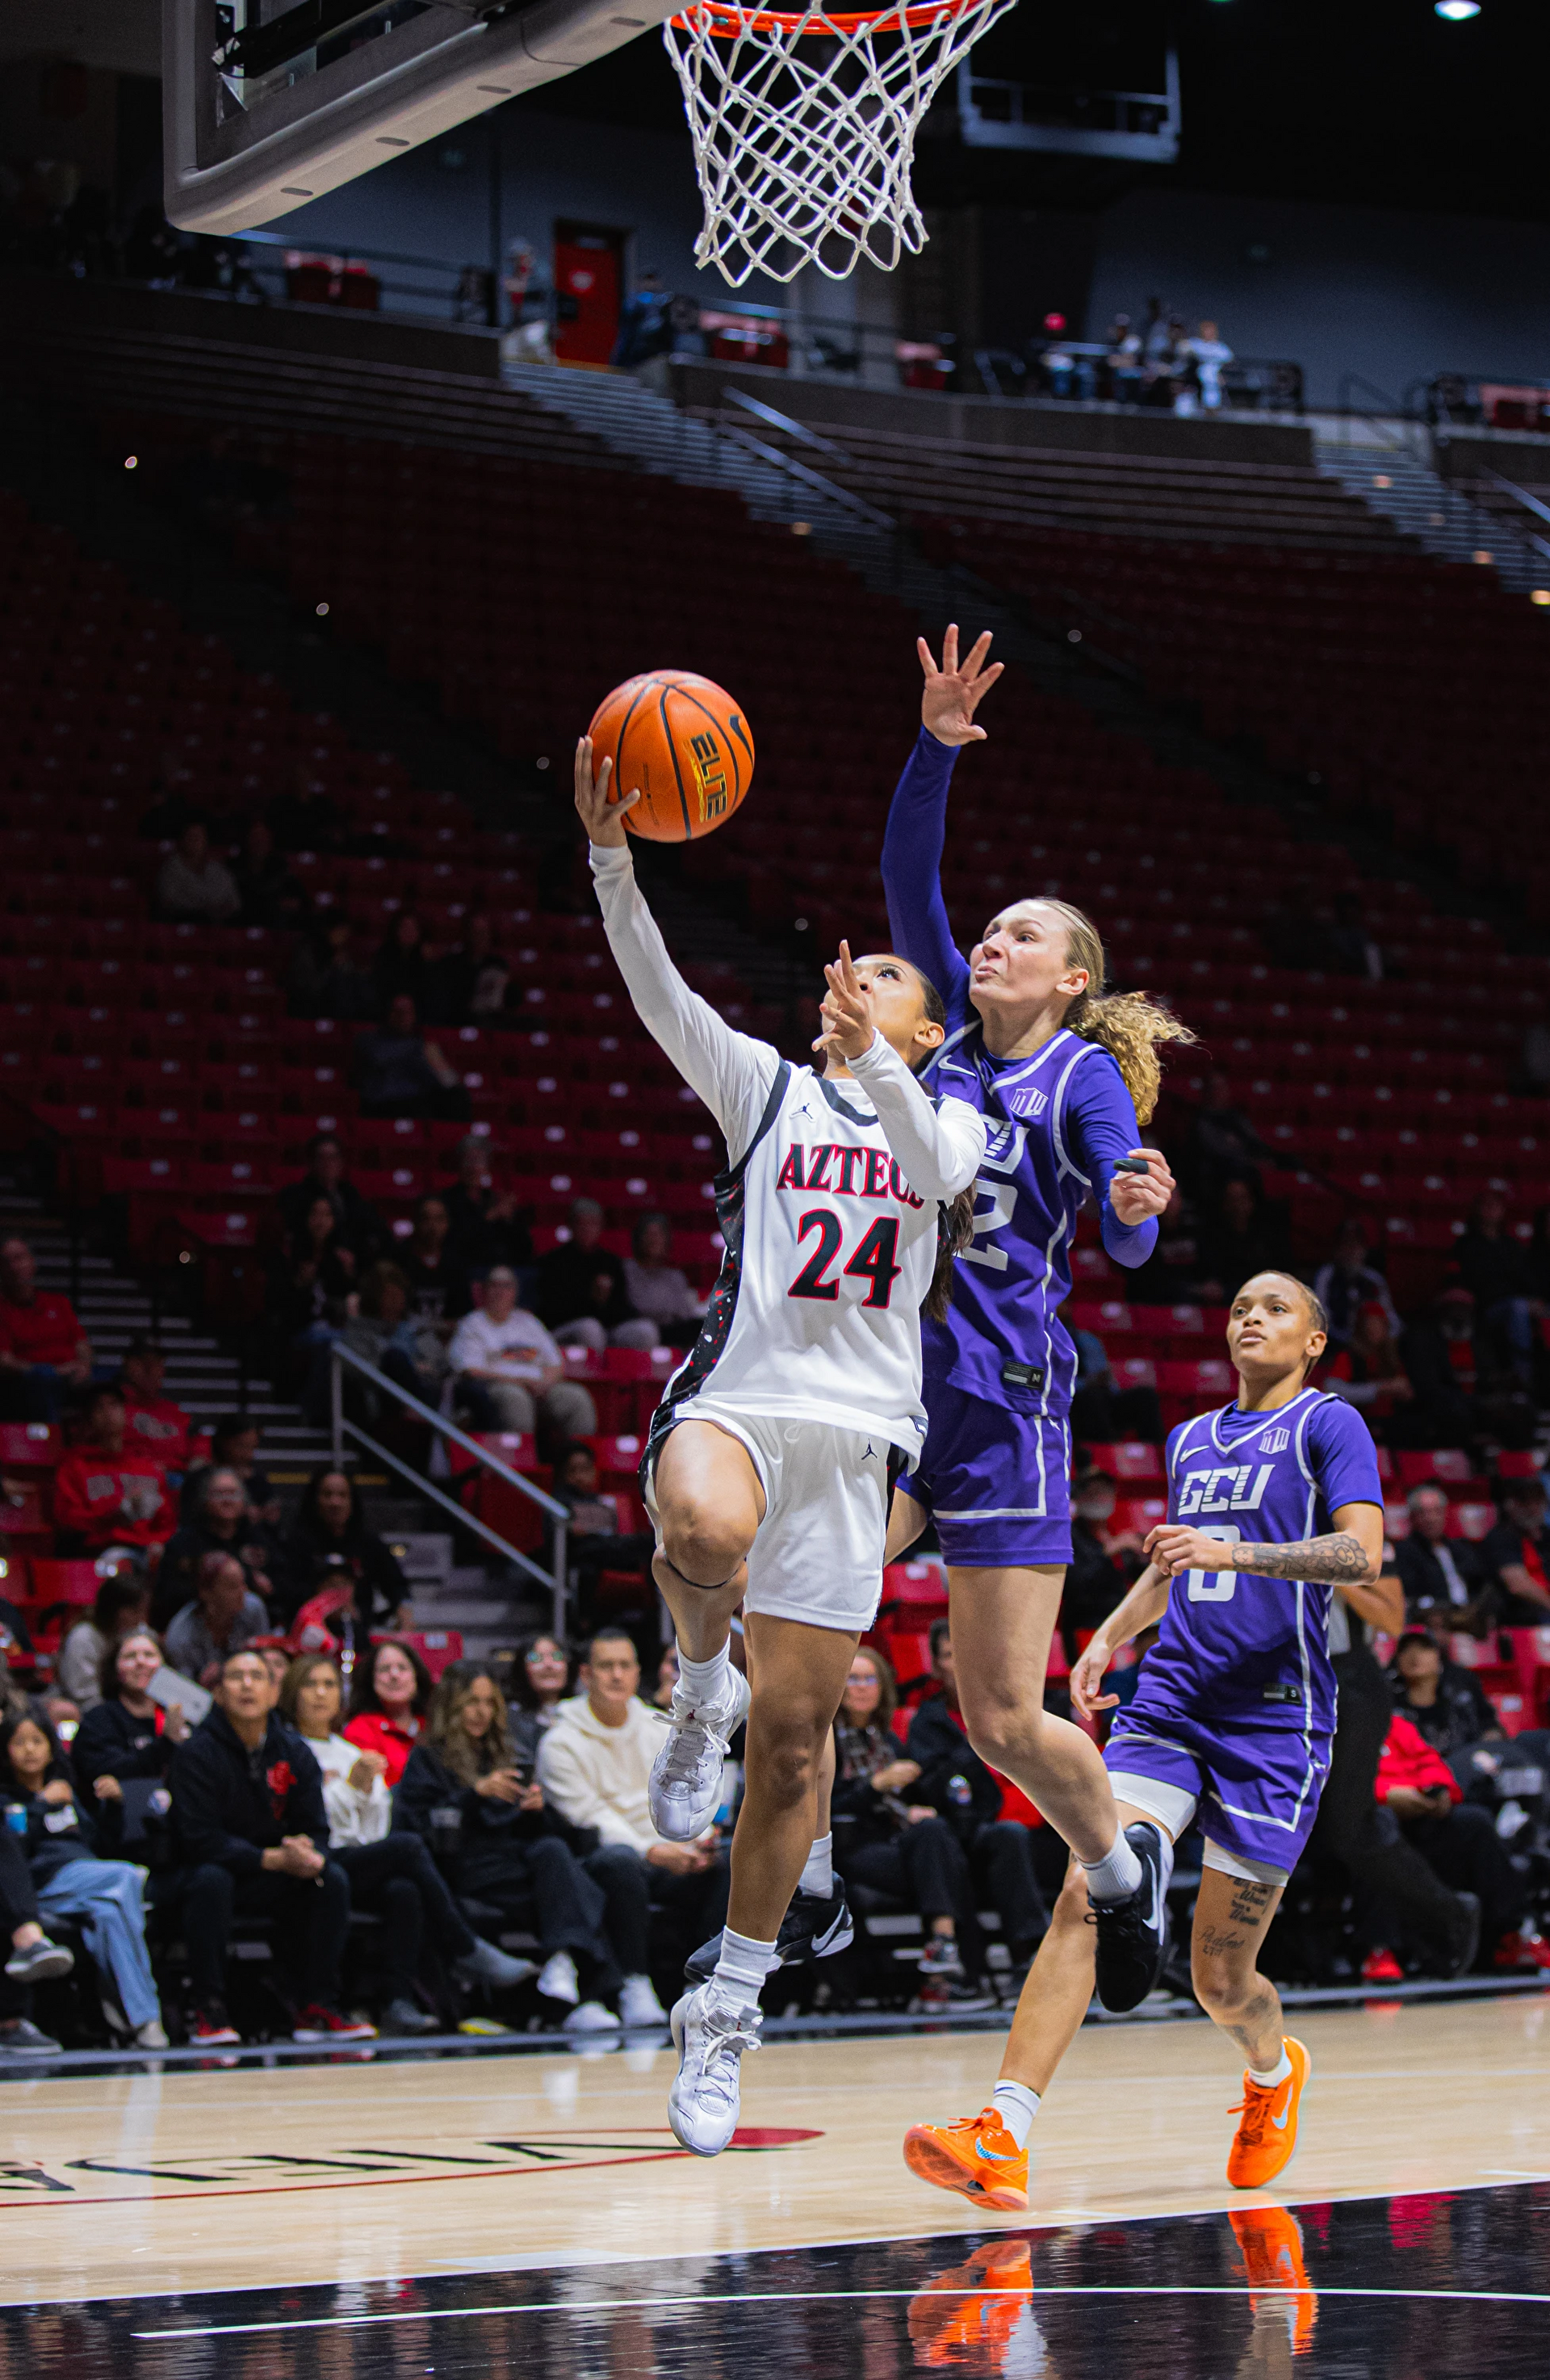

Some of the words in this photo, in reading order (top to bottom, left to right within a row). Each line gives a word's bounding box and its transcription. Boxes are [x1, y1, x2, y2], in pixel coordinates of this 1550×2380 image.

[690, 731, 727, 822] ELITE
[777, 1143, 924, 1209] AZTEC
[788, 1209, 902, 1309] 24
[1178, 1464, 1276, 1516] GCU
[1290, 1690, 1297, 1698] S
